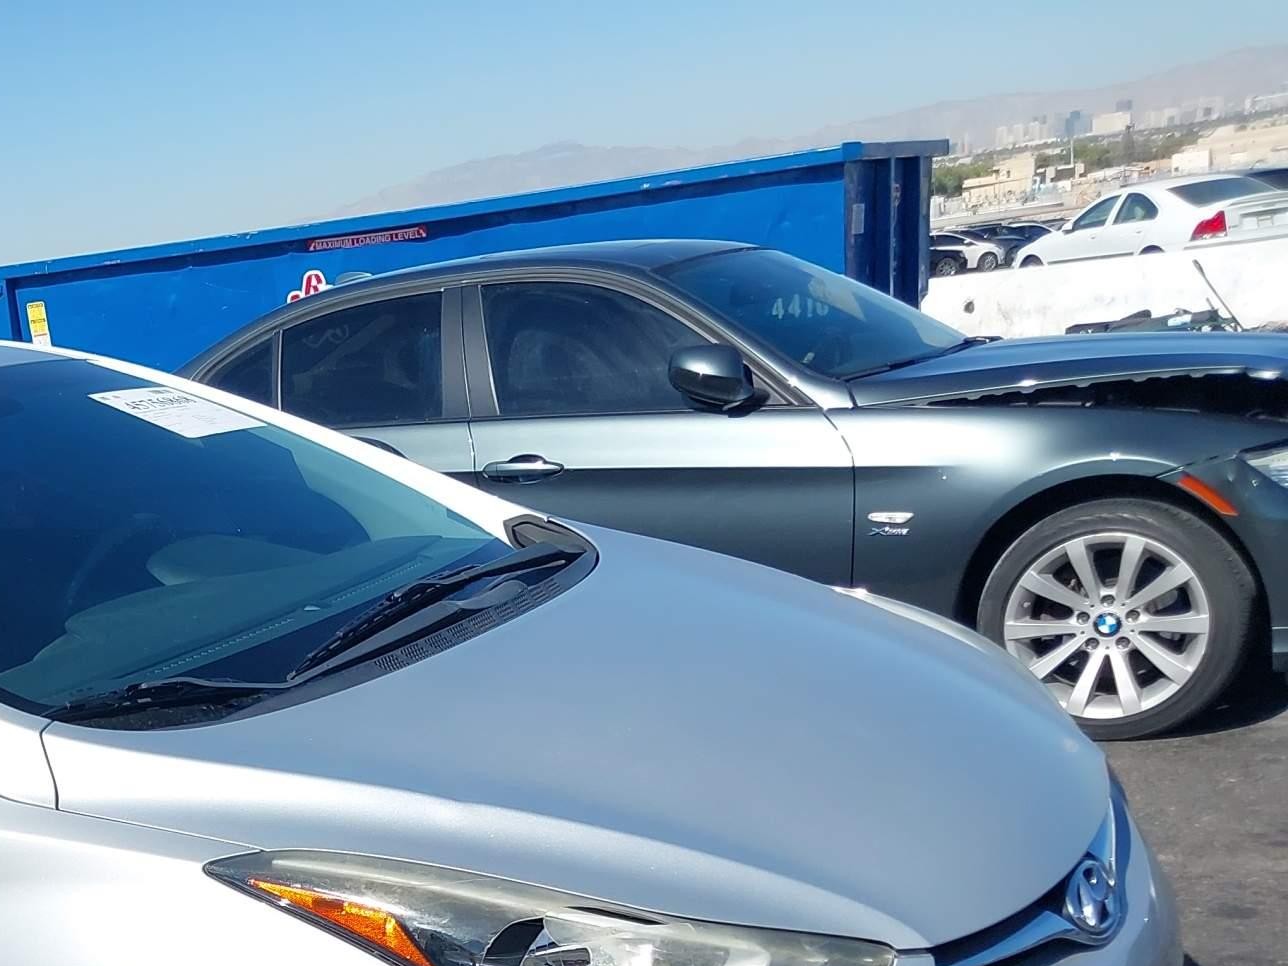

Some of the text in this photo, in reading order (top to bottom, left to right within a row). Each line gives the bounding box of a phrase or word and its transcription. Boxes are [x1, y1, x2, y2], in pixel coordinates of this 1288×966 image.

[315, 230, 421, 250] MAXIMUM LOADING LEVEL
